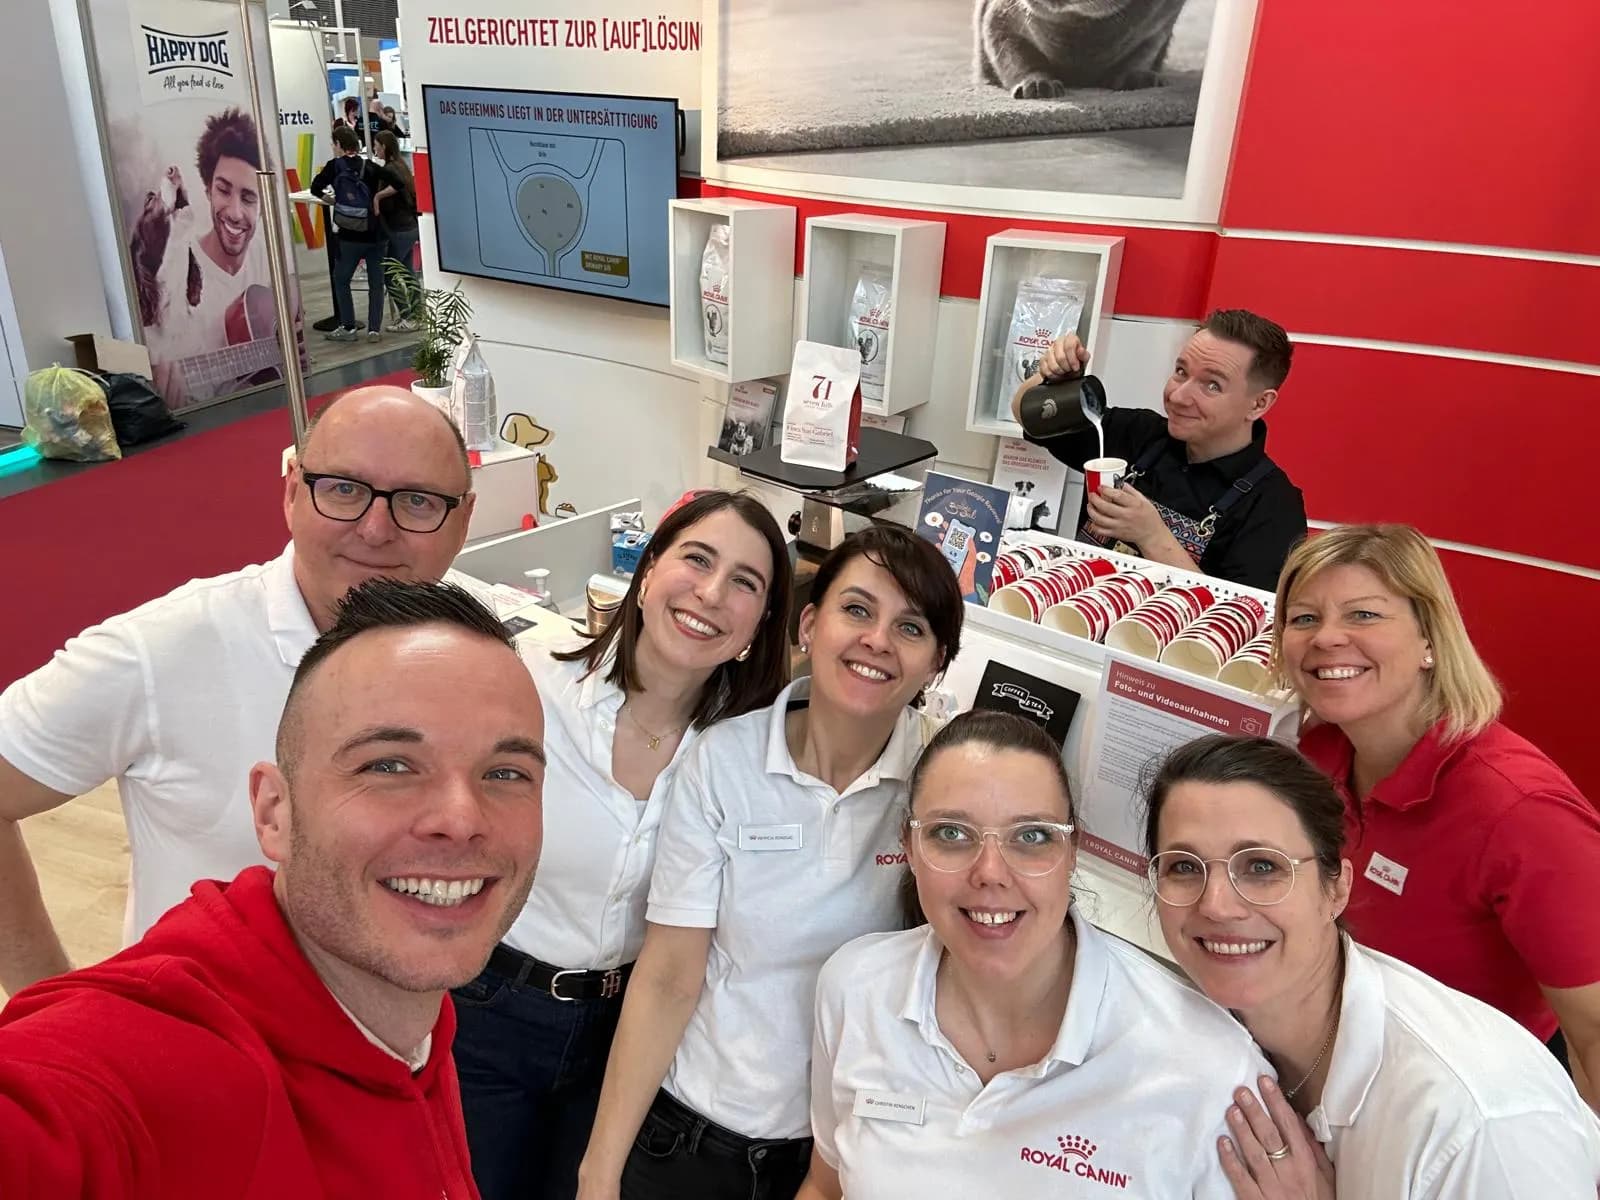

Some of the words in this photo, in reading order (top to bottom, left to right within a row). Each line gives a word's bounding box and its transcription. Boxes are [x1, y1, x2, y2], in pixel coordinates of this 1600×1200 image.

[427, 17, 559, 47] ZIELGERICHTET
[564, 19, 598, 48] ZUR
[602, 15, 702, 53] [AUF]LÖSUN
[145, 33, 196, 66] HAPPY
[198, 39, 230, 68] DOG
[163, 75, 176, 89] All
[177, 79, 190, 92] you
[204, 79, 211, 88] is
[440, 100, 457, 115] DAS
[459, 102, 505, 119] GEHEIMNIS
[507, 105, 532, 120] LIEGT
[534, 106, 544, 121] IN
[546, 107, 565, 122] DER
[1115, 670, 1146, 687] Hinweis
[1146, 682, 1156, 690] zu
[1003, 686, 1025, 697] COFFEE
[1031, 701, 1042, 710] TEA
[1113, 680, 1137, 694] Foto-
[1138, 689, 1154, 701] und
[1155, 694, 1230, 727] Videoaufnahmen
[875, 853, 909, 866] ROYA
[1089, 841, 1113, 857] ROYAL
[1114, 852, 1138, 867] CANIN
[1020, 1147, 1070, 1173] ROYAL
[1074, 1161, 1127, 1189] CANIN
